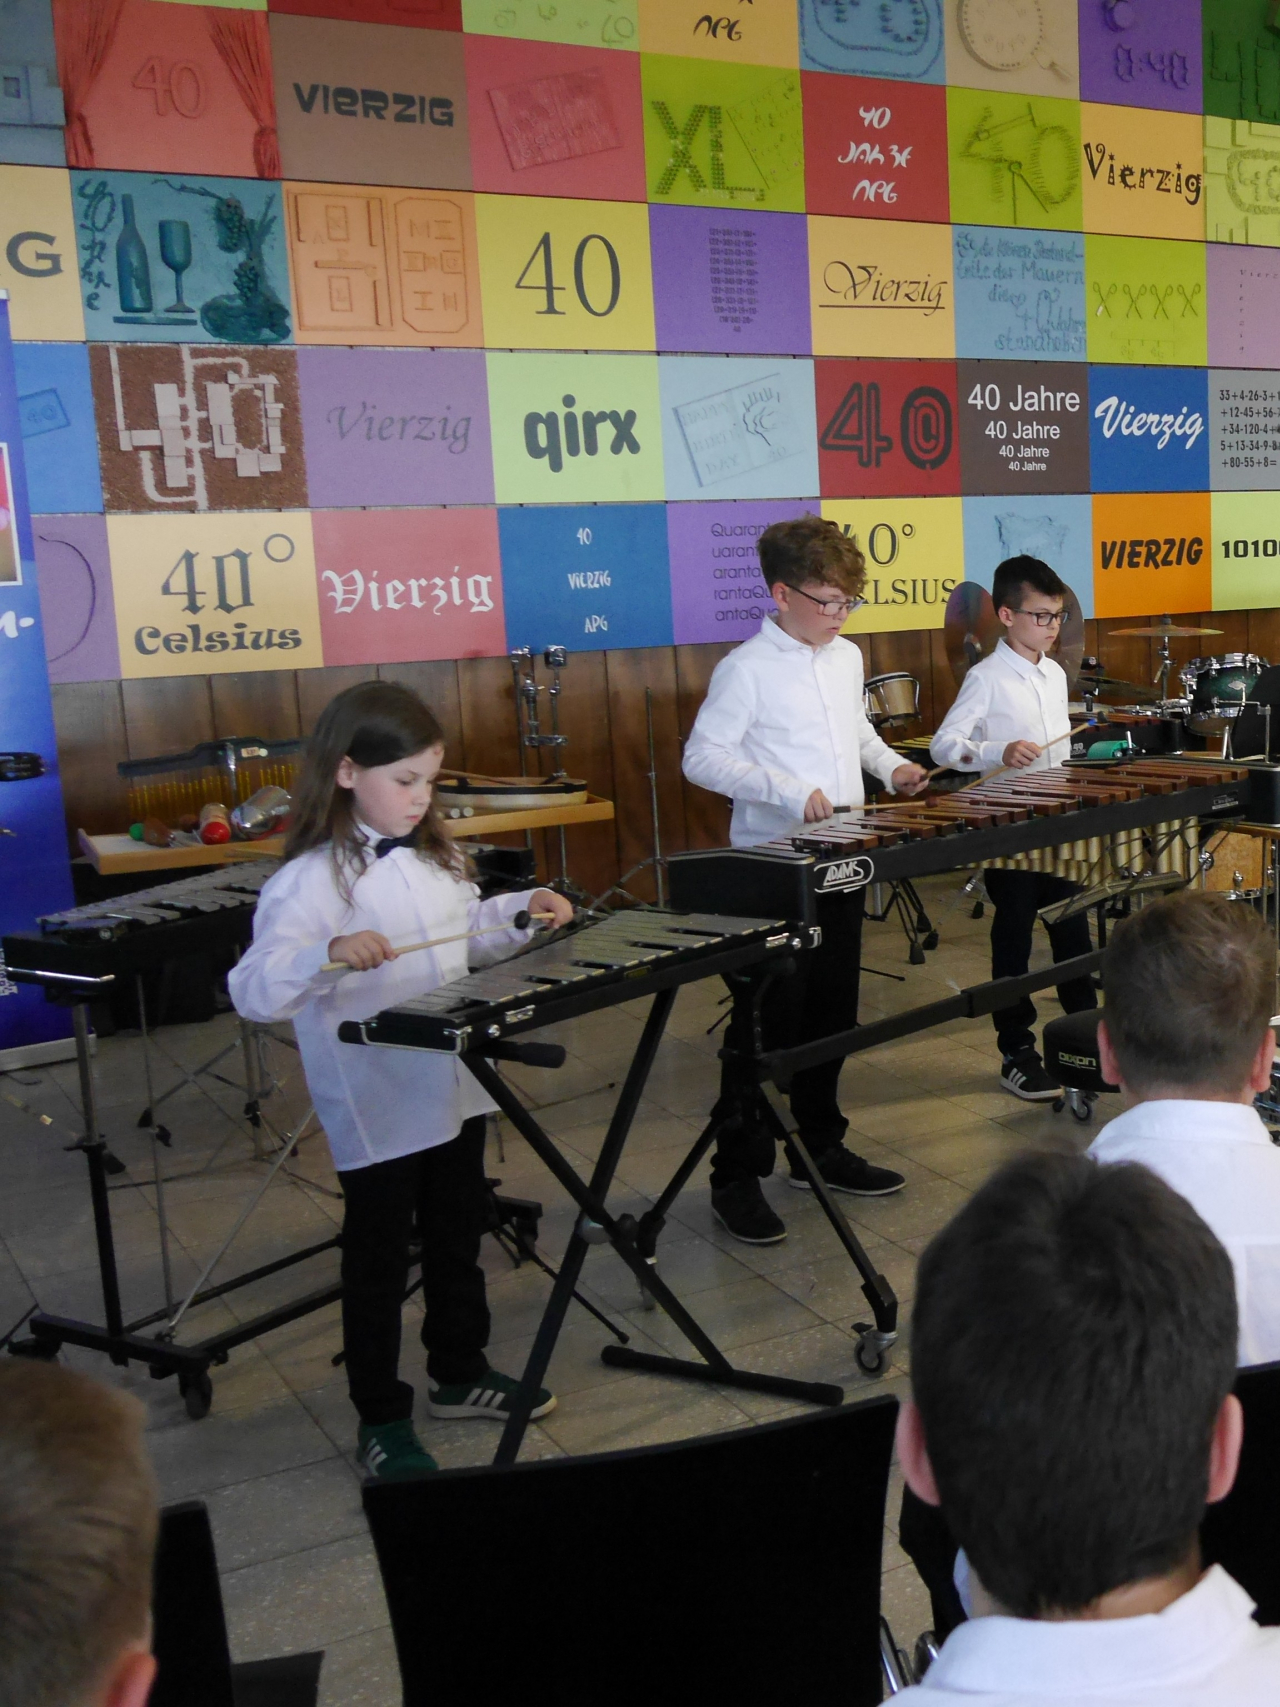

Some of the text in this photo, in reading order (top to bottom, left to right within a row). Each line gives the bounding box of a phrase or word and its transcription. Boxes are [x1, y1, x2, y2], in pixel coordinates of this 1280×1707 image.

[132, 56, 204, 119] 40
[859, 107, 890, 129] 40
[652, 101, 764, 201] XL
[1083, 142, 1201, 206] Vierzig
[515, 232, 620, 317] 40
[823, 261, 948, 316] Vierzig
[967, 383, 1080, 412] 40 Jahre
[326, 402, 472, 454] Vierzig
[524, 394, 641, 473] qirx
[820, 382, 952, 470] 40
[985, 421, 1060, 440] 40 Jahre
[1094, 396, 1204, 450] Vierzig
[999, 444, 1050, 458] 40 Jahre
[1008, 461, 1047, 472] 40 Jahre
[577, 527, 592, 545] 40
[1101, 537, 1203, 570] VIERZIG
[321, 565, 493, 616] Vierzig
[134, 622, 302, 656] Celsius
[584, 615, 608, 633] APG
[823, 861, 865, 886] ADAMS
